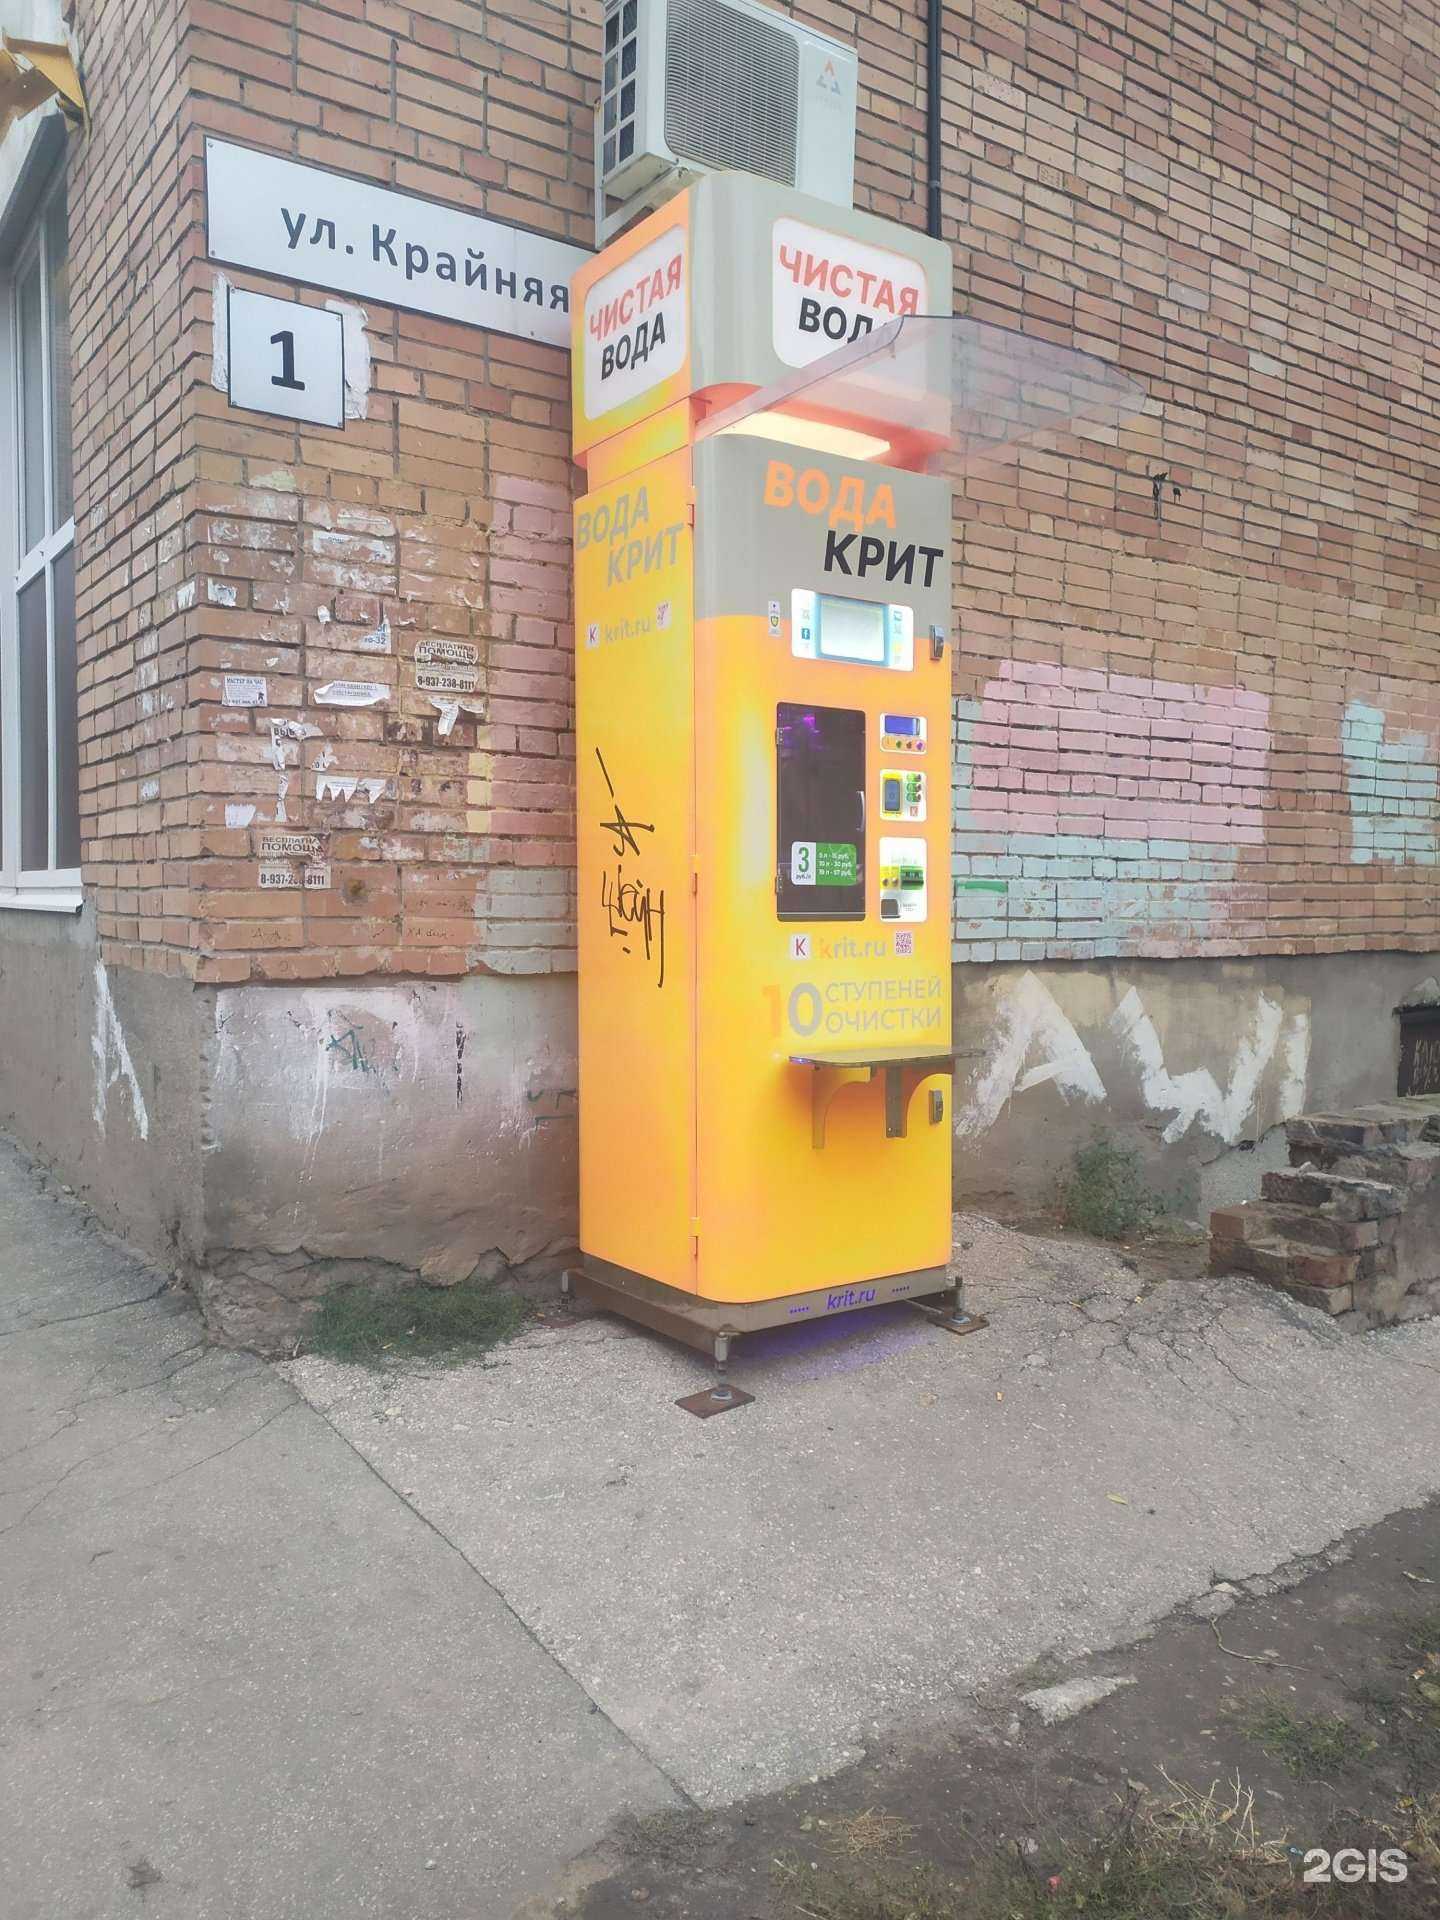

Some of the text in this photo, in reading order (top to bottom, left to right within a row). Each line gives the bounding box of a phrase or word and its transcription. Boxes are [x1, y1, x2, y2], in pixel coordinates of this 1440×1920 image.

[281, 208, 569, 313] ул. Крайняя
[778, 244, 919, 317] ЧИСТАЯ
[589, 254, 683, 342] ЧИСТАЯ
[798, 296, 888, 345] ВОД
[269, 330, 306, 391] 1
[600, 312, 667, 381] ВОДА
[576, 486, 650, 550] ВОДА
[763, 460, 897, 532] ВОДА
[606, 522, 686, 588] КРИТ
[823, 530, 945, 588] КРИТ
[419, 646, 474, 660] ПОМОЩЬ
[604, 617, 652, 643] krit.ru
[417, 675, 475, 690] 8-937-238-8111
[798, 847, 809, 873] 3
[820, 936, 887, 959] krit.ru
[762, 975, 942, 1037] 10 СТУПЕНЕЙ
[825, 1007, 942, 1034] ОЧИСТКИ
[826, 1288, 876, 1310] krit.ru
